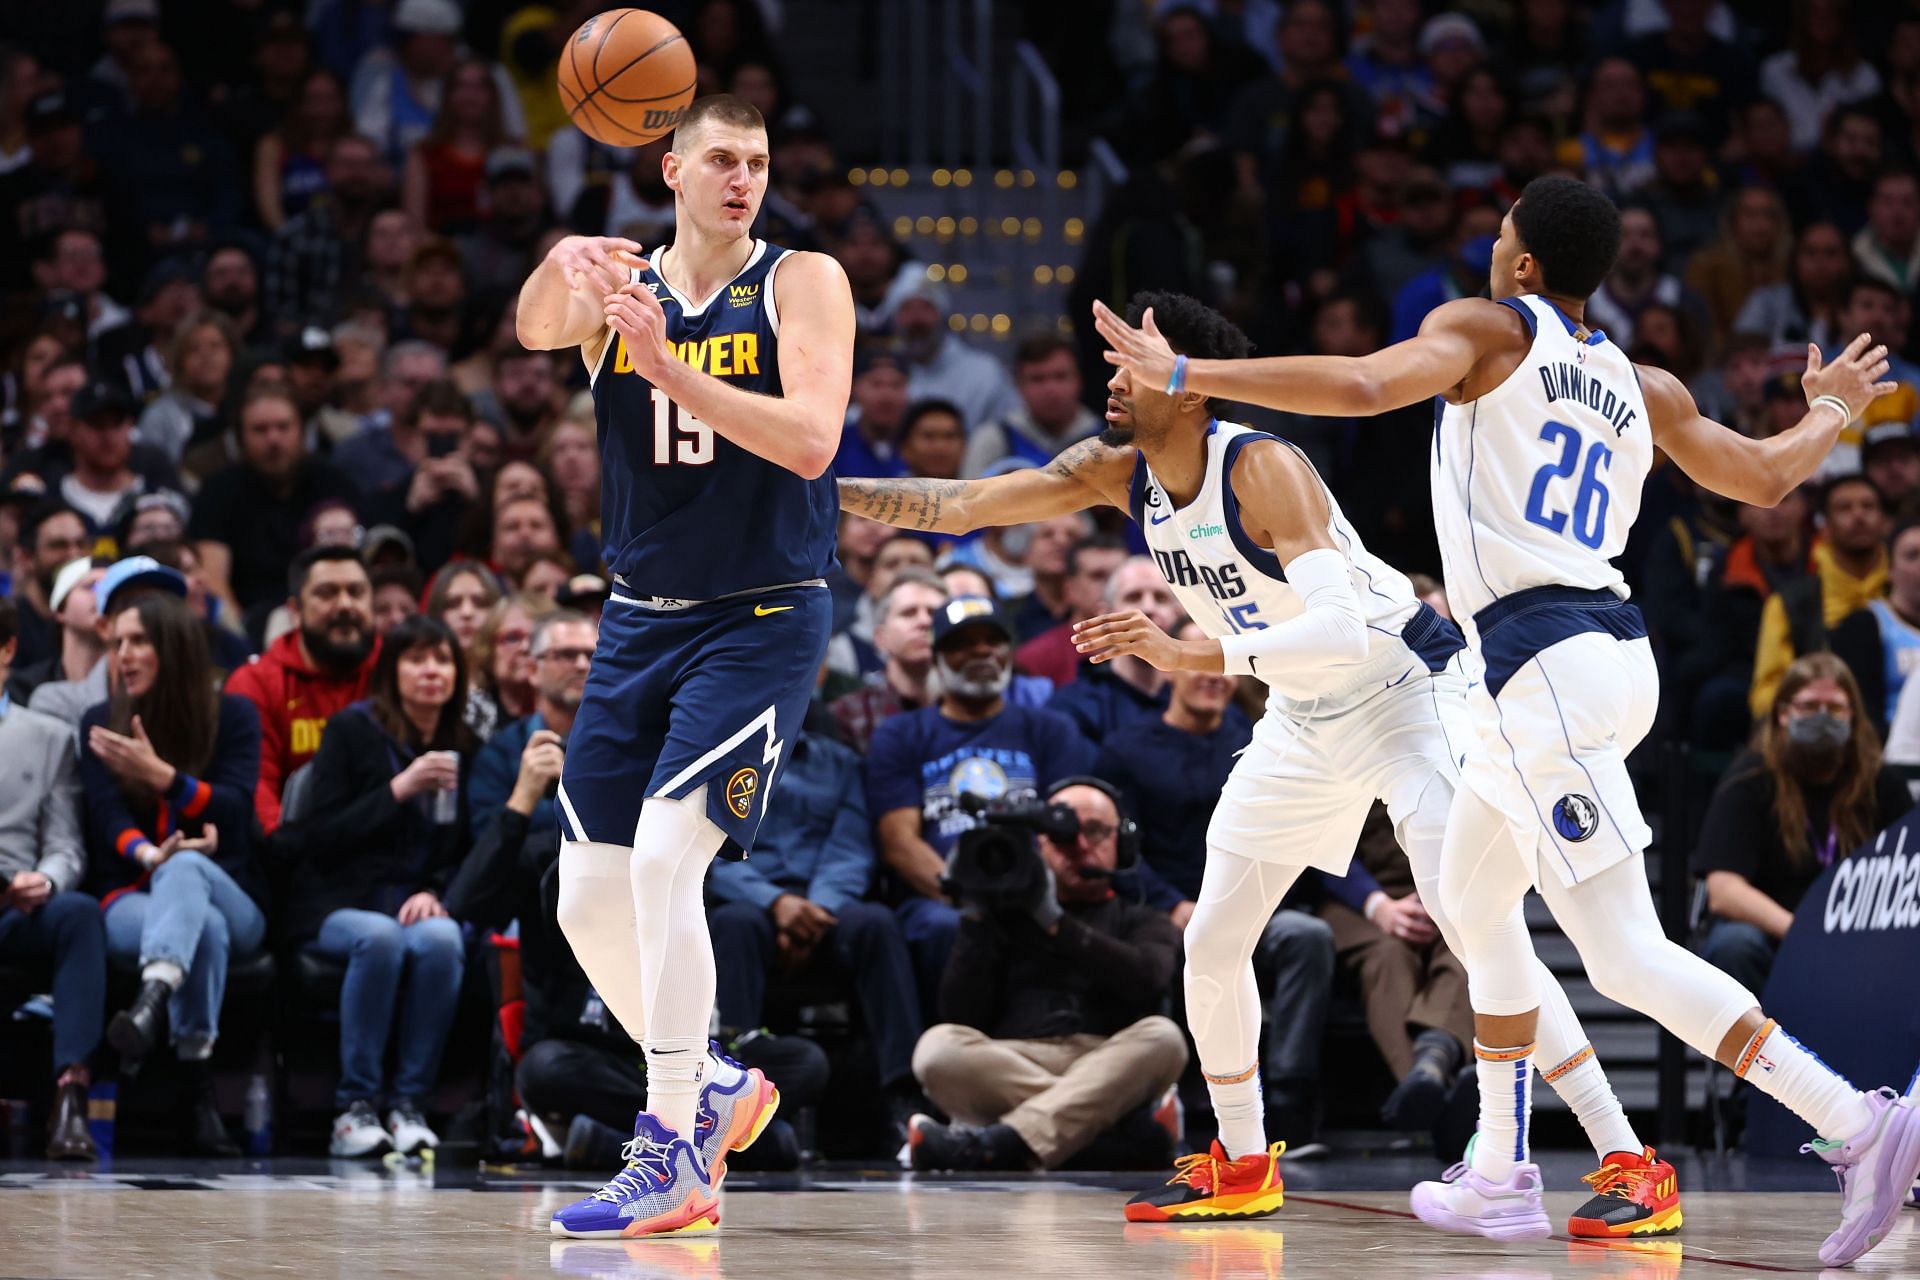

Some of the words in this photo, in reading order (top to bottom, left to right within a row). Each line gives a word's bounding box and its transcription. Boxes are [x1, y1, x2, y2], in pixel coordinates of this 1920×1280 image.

[643, 105, 686, 129] Wil
[729, 295, 757, 303] Western
[730, 283, 759, 297] WU
[1538, 361, 1637, 438] DINWIDDIE
[651, 388, 714, 465] 15
[1525, 420, 1613, 550] 26
[1153, 549, 1247, 600] DAAS
